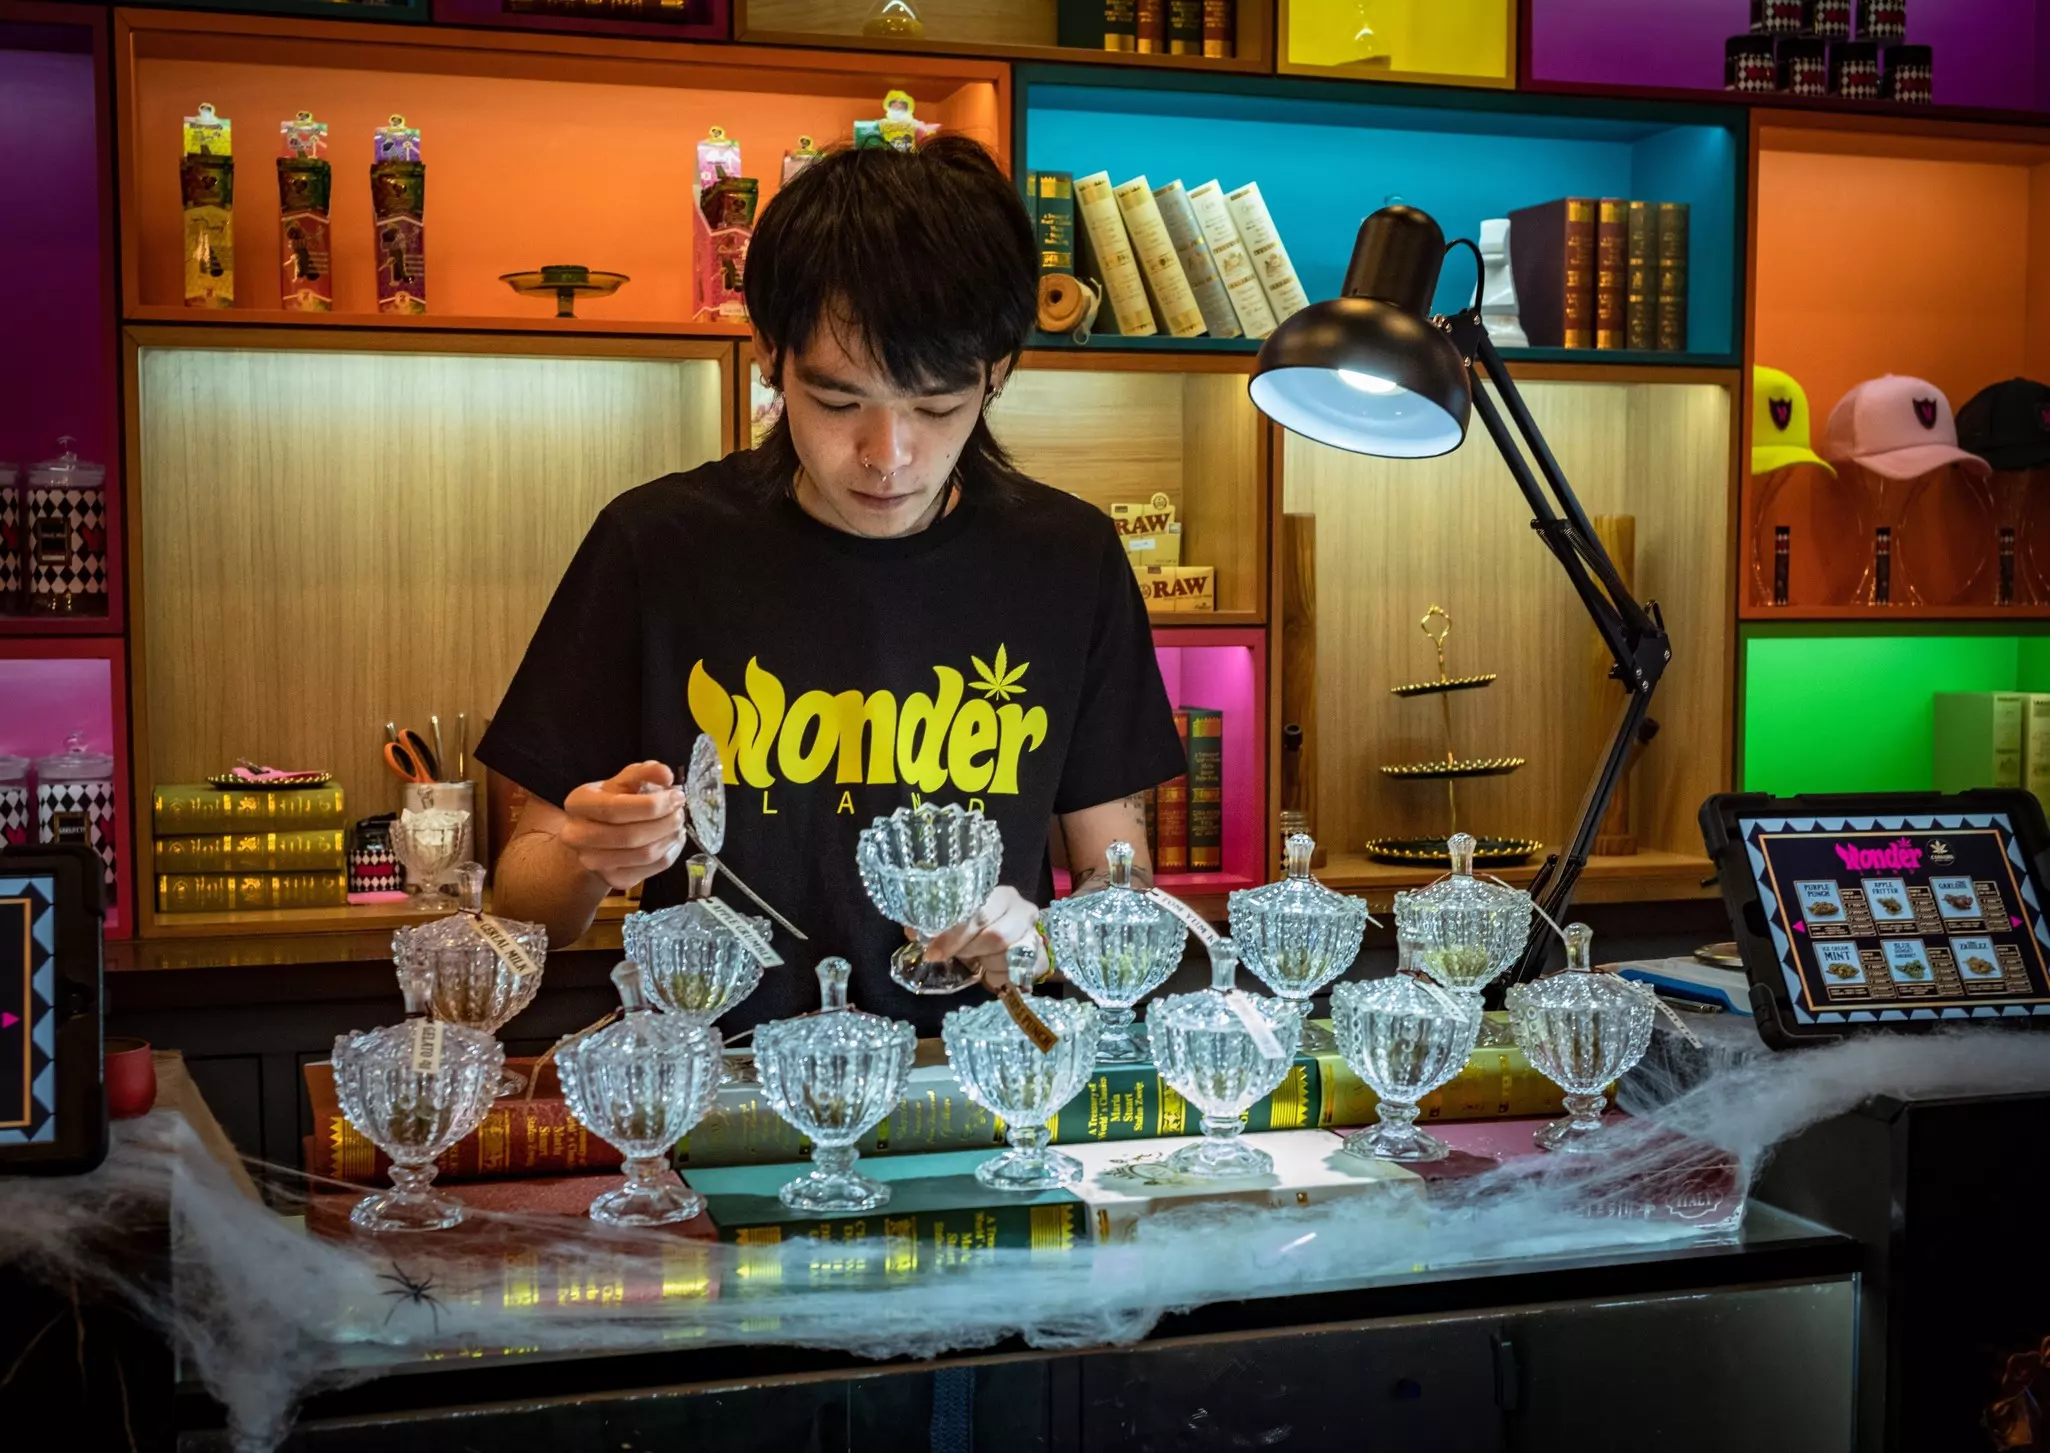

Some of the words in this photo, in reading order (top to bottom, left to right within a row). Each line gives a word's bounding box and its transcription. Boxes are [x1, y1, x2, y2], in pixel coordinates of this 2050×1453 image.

[1114, 513, 1171, 535] RAW
[1152, 576, 1208, 598] RAW
[687, 656, 1048, 794] Wonder
[1835, 842, 1922, 871] Wonder
[713, 905, 738, 924] APPLE
[1186, 912, 1207, 934] YUM
[480, 923, 511, 950] CEREAL
[504, 949, 528, 972] MILK
[1824, 951, 1850, 961] MINT
[420, 1026, 437, 1058] GELATO
[1110, 1093, 1121, 1122] Maria
[1123, 1093, 1133, 1122] Stuart
